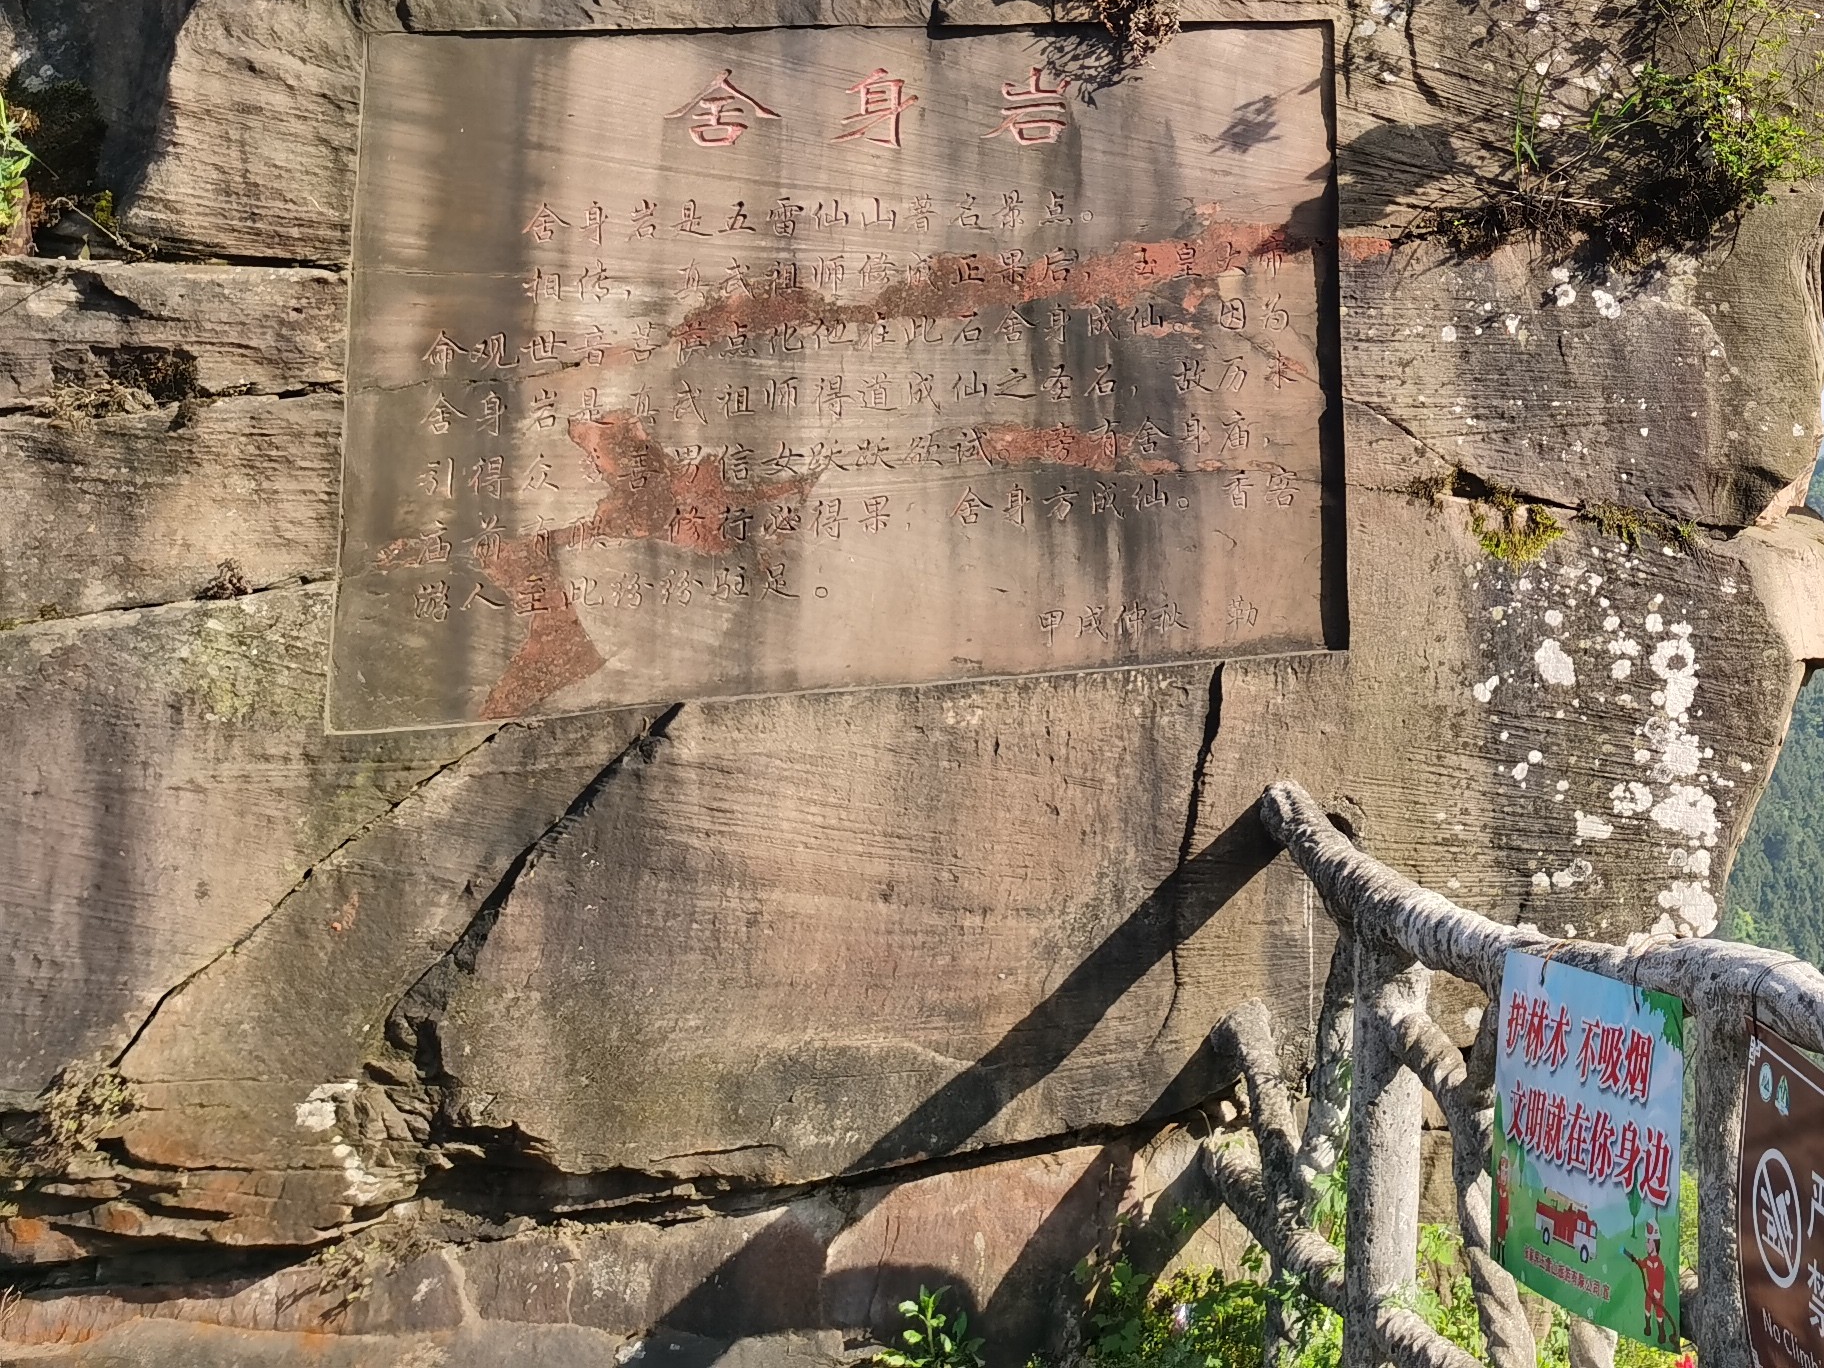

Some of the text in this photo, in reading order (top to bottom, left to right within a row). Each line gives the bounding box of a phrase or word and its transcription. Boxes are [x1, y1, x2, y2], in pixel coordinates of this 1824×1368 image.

[664, 66, 1072, 148] 舍身岩
[1505, 989, 1655, 1104] 护林木 不吸烟
[1506, 1078, 1673, 1206] 文明就在你身边
[1762, 1307, 1781, 1344] No
